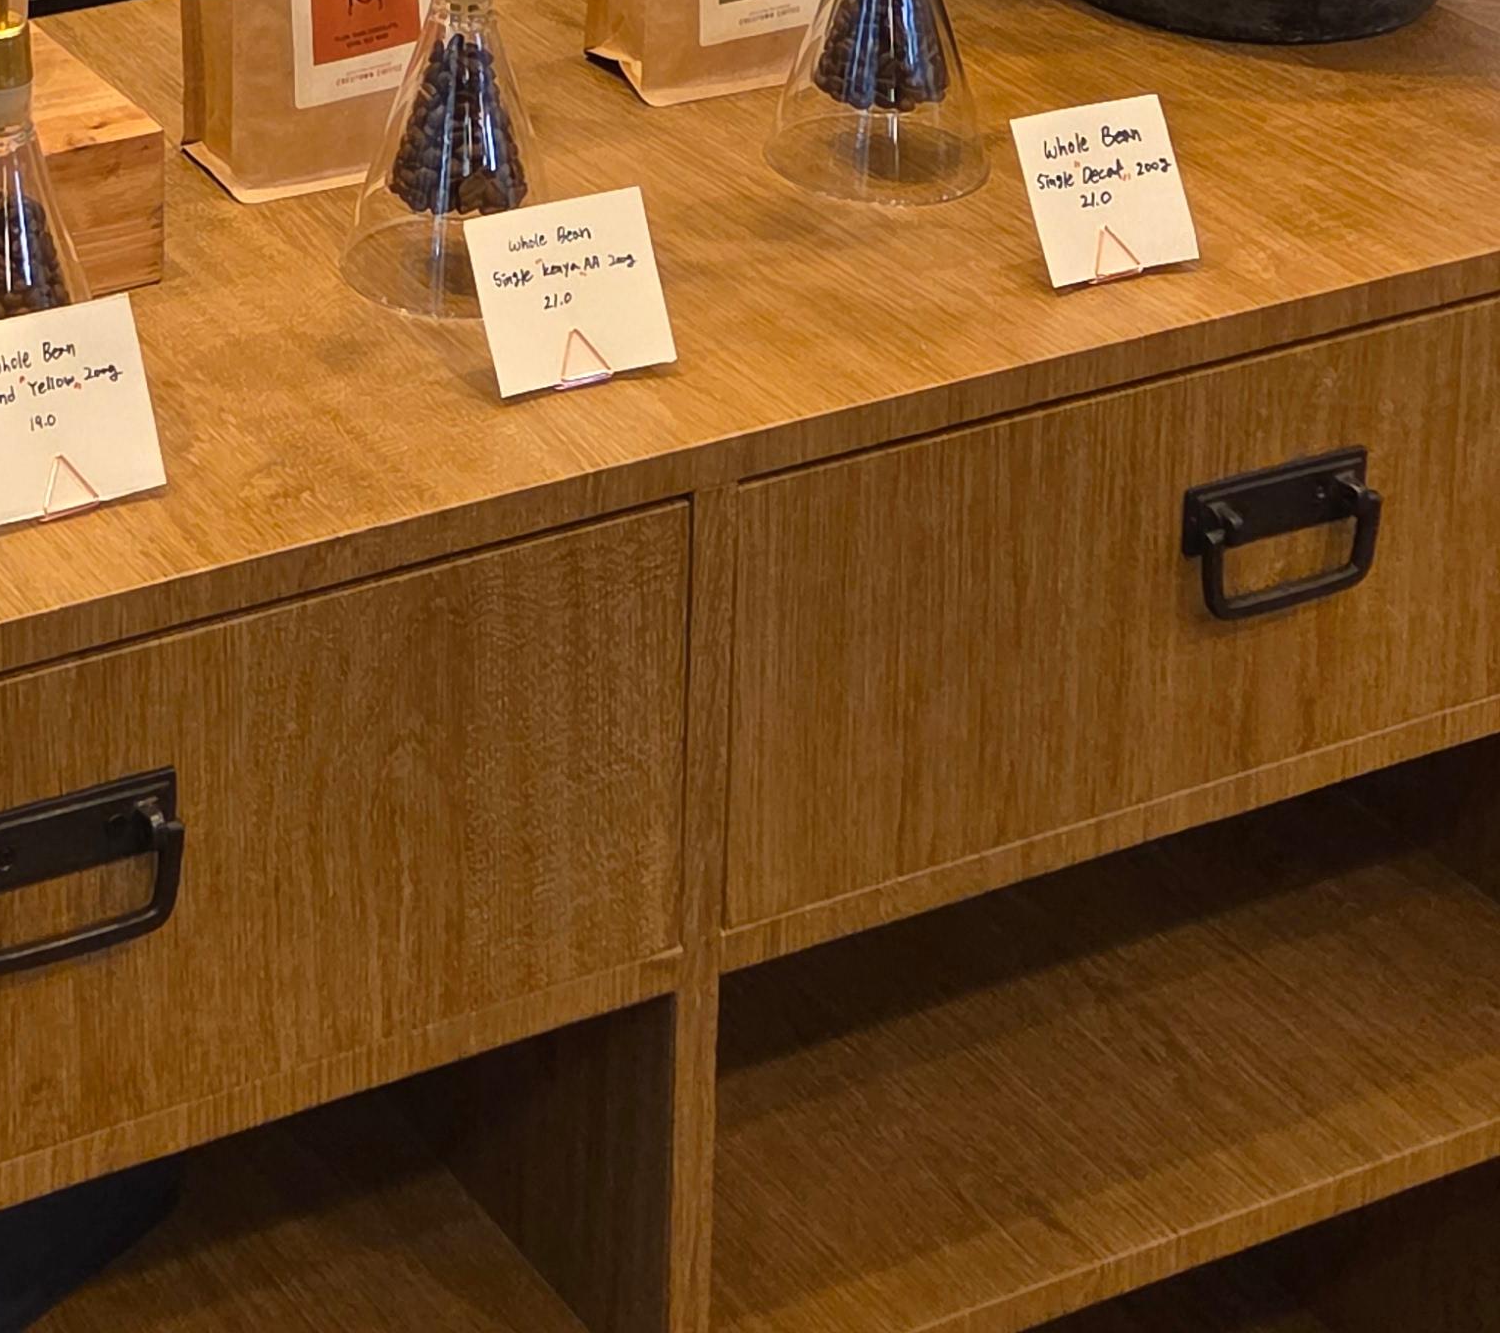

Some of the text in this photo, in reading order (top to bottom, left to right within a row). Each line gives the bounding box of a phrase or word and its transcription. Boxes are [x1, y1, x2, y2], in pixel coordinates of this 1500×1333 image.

[1080, 190, 1113, 208] 21.0
[492, 268, 534, 288] Single
[583, 255, 600, 270] AA
[543, 291, 572, 309] 21.0
[29, 414, 57, 432] 19.0
